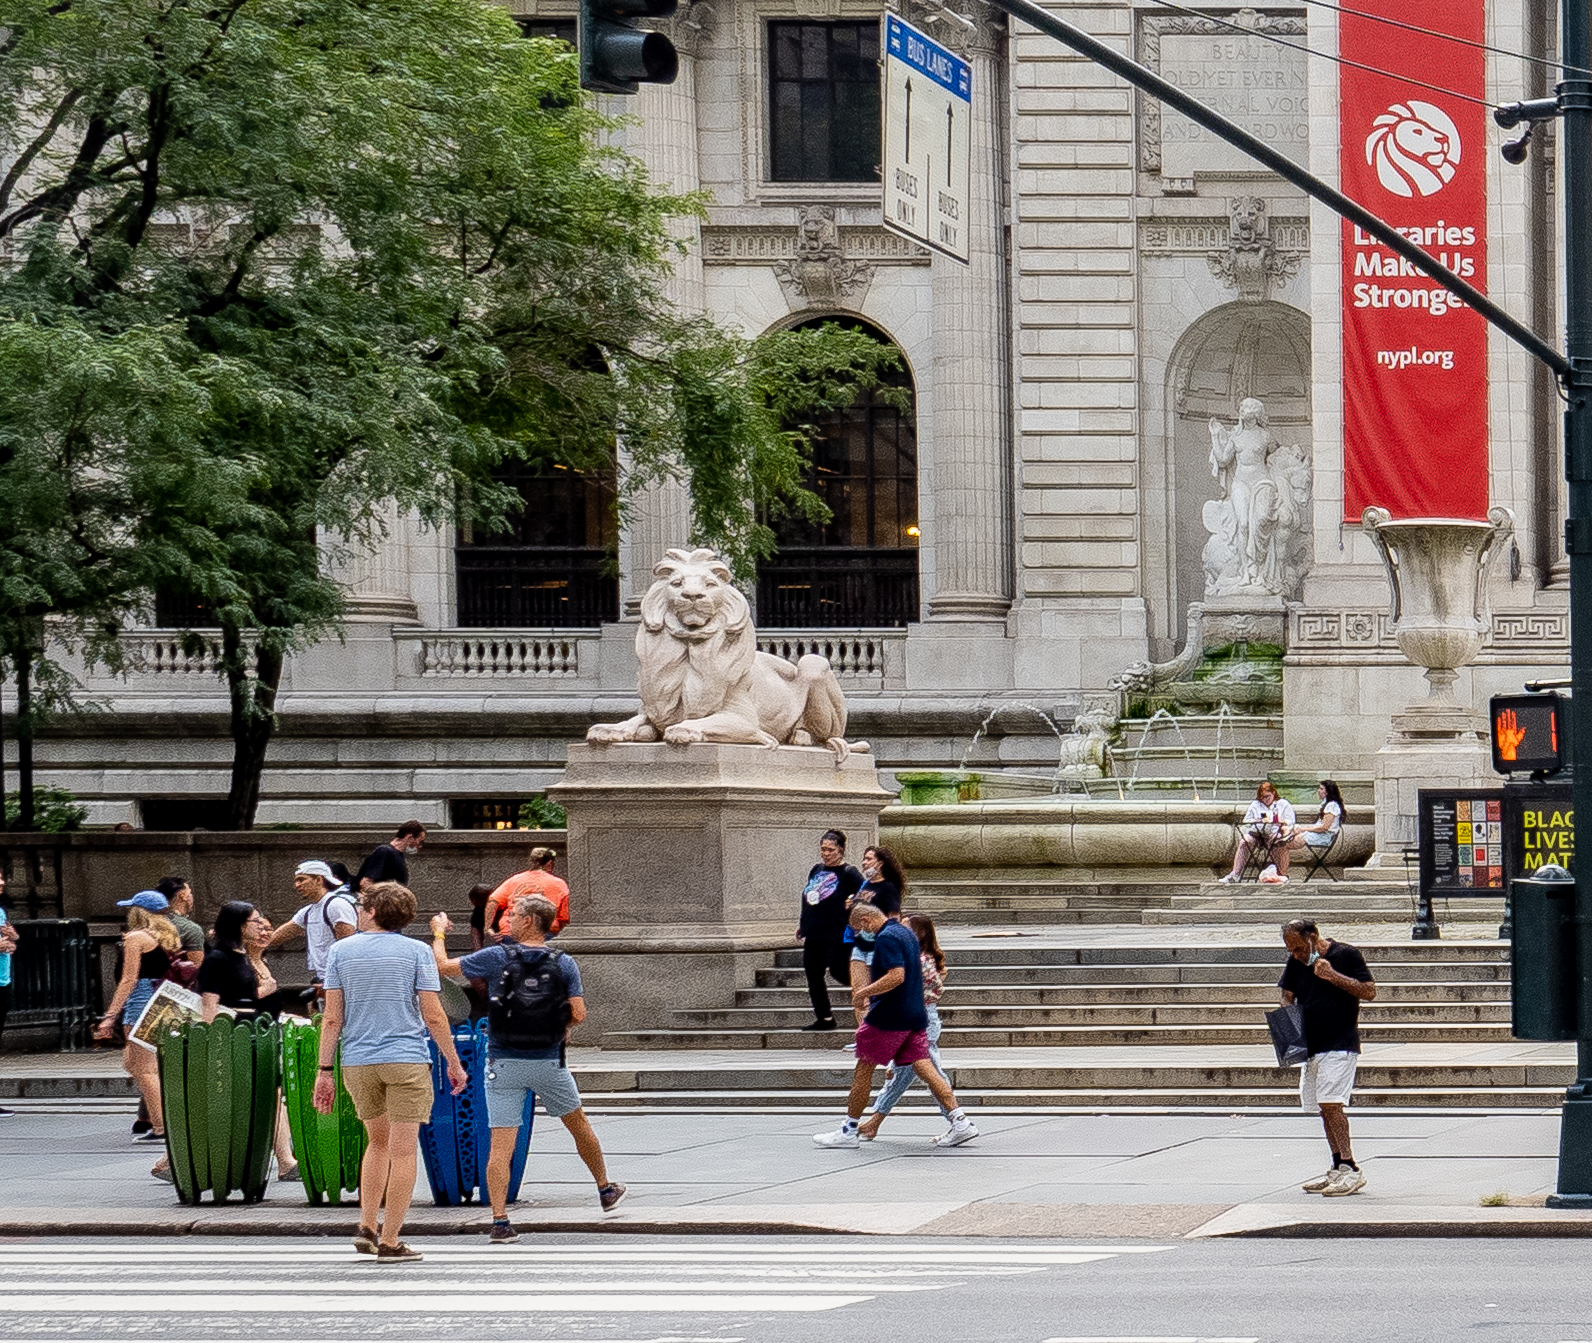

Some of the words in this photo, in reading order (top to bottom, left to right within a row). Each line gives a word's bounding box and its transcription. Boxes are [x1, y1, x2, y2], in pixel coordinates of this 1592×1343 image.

[907, 36, 924, 66] BUS
[926, 48, 953, 84] LANES
[1212, 44, 1285, 61] BEAUTY
[1243, 70, 1285, 86] EVER
[1266, 97, 1309, 113] VOIC
[896, 167, 918, 199] BUSES
[896, 198, 916, 227] ONLY
[938, 190, 959, 221] BUSES
[940, 221, 958, 248] ONLY
[1353, 220, 1476, 246] Lraries
[1438, 252, 1475, 277] Us
[1353, 283, 1471, 316] Stronge
[1377, 346, 1454, 370] nypl.org
[1523, 810, 1574, 828] BLAC
[1524, 852, 1574, 869] MAT
